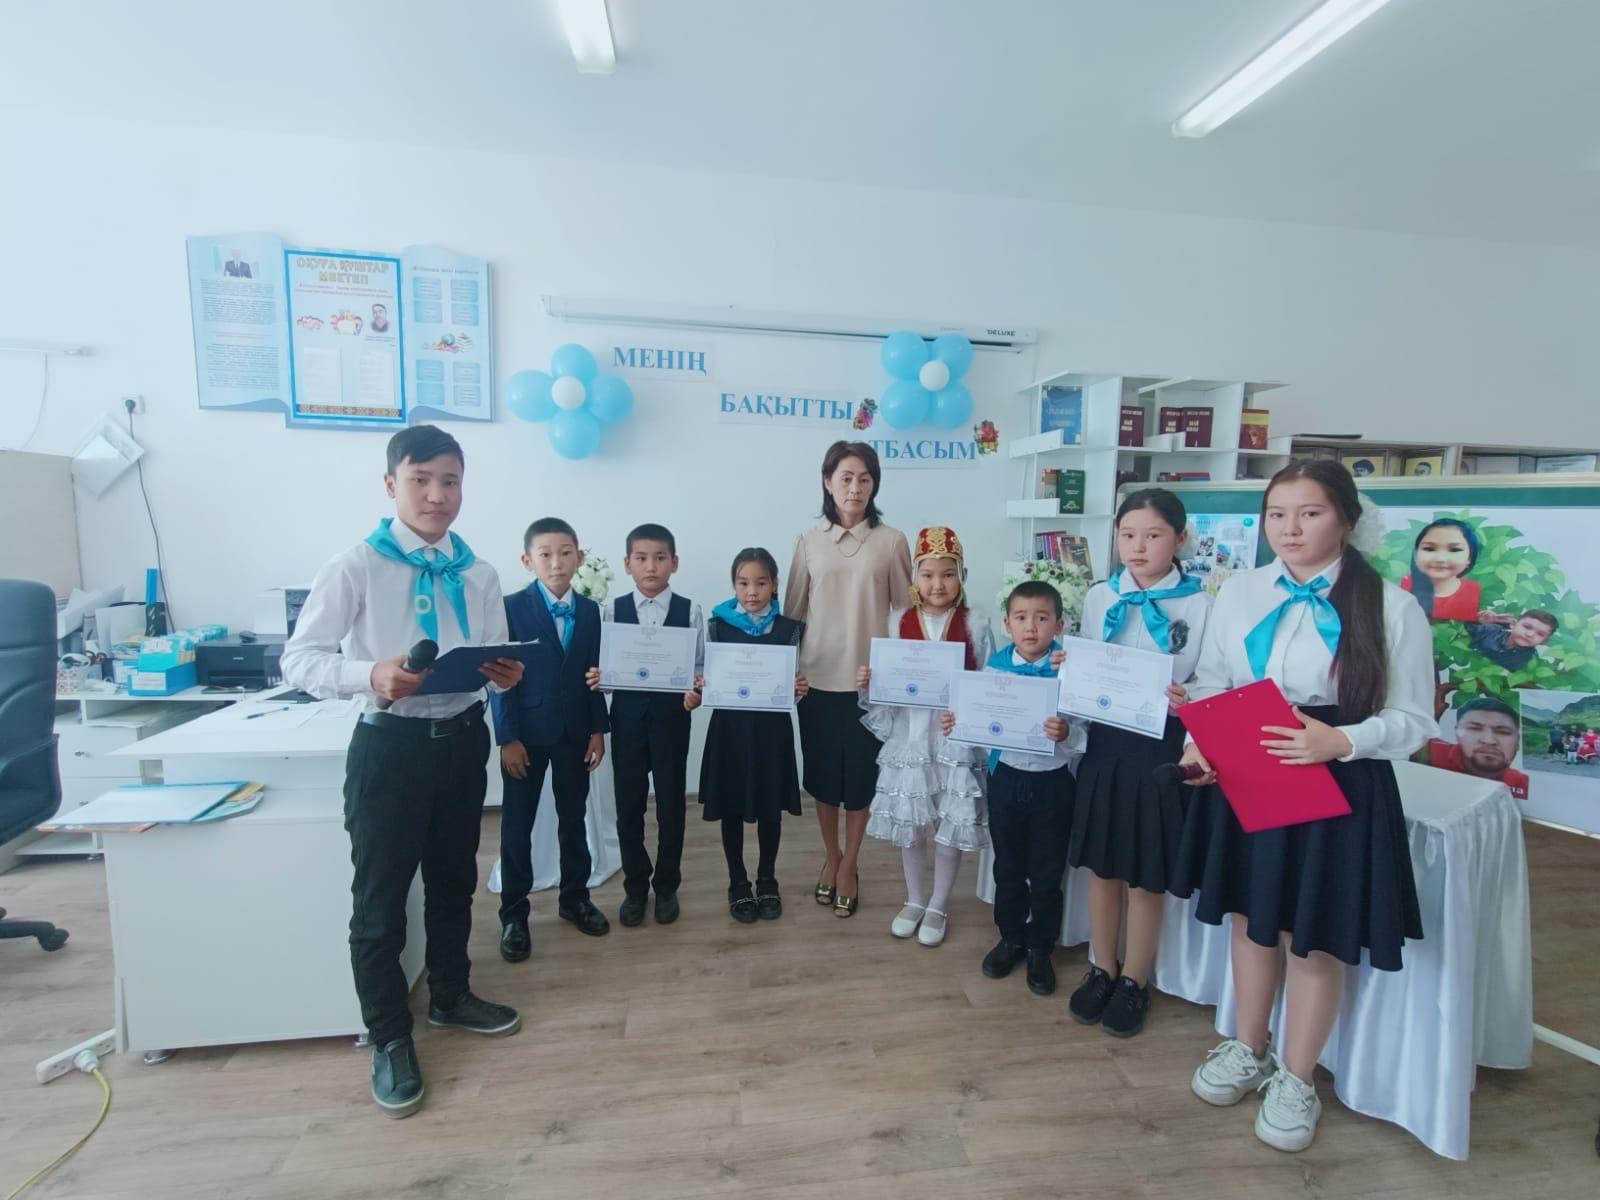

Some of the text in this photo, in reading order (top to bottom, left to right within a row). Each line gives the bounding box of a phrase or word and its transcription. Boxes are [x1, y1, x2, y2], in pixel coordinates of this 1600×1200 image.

[986, 329, 1017, 337] DELUXE
[613, 346, 707, 376] МЕНІҢ
[720, 392, 854, 420] БАҚЫТТЫ
[855, 439, 977, 460] ТБАСЫМ
